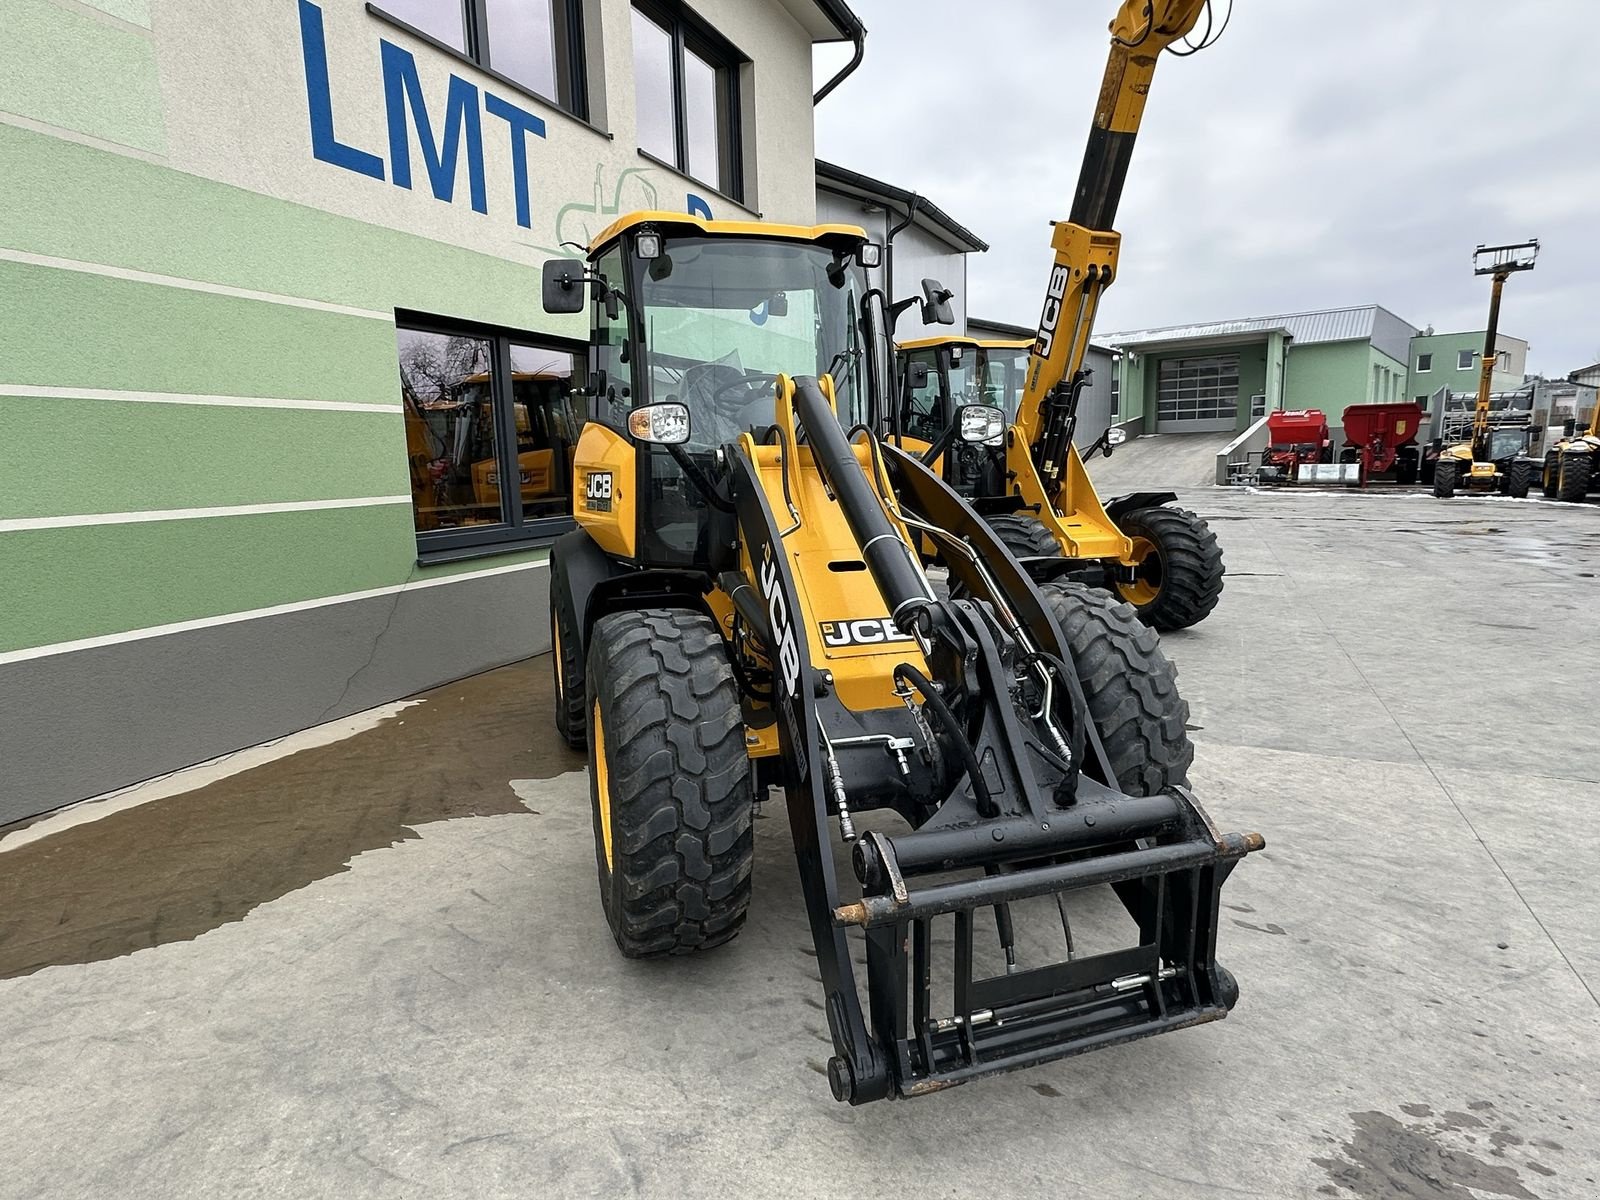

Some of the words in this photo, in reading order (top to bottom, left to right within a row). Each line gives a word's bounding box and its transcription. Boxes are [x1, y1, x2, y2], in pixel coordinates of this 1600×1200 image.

[298, 0, 546, 229] LMT
[1038, 266, 1068, 356] JCB
[587, 474, 612, 498] JCB
[761, 560, 800, 697] JCB
